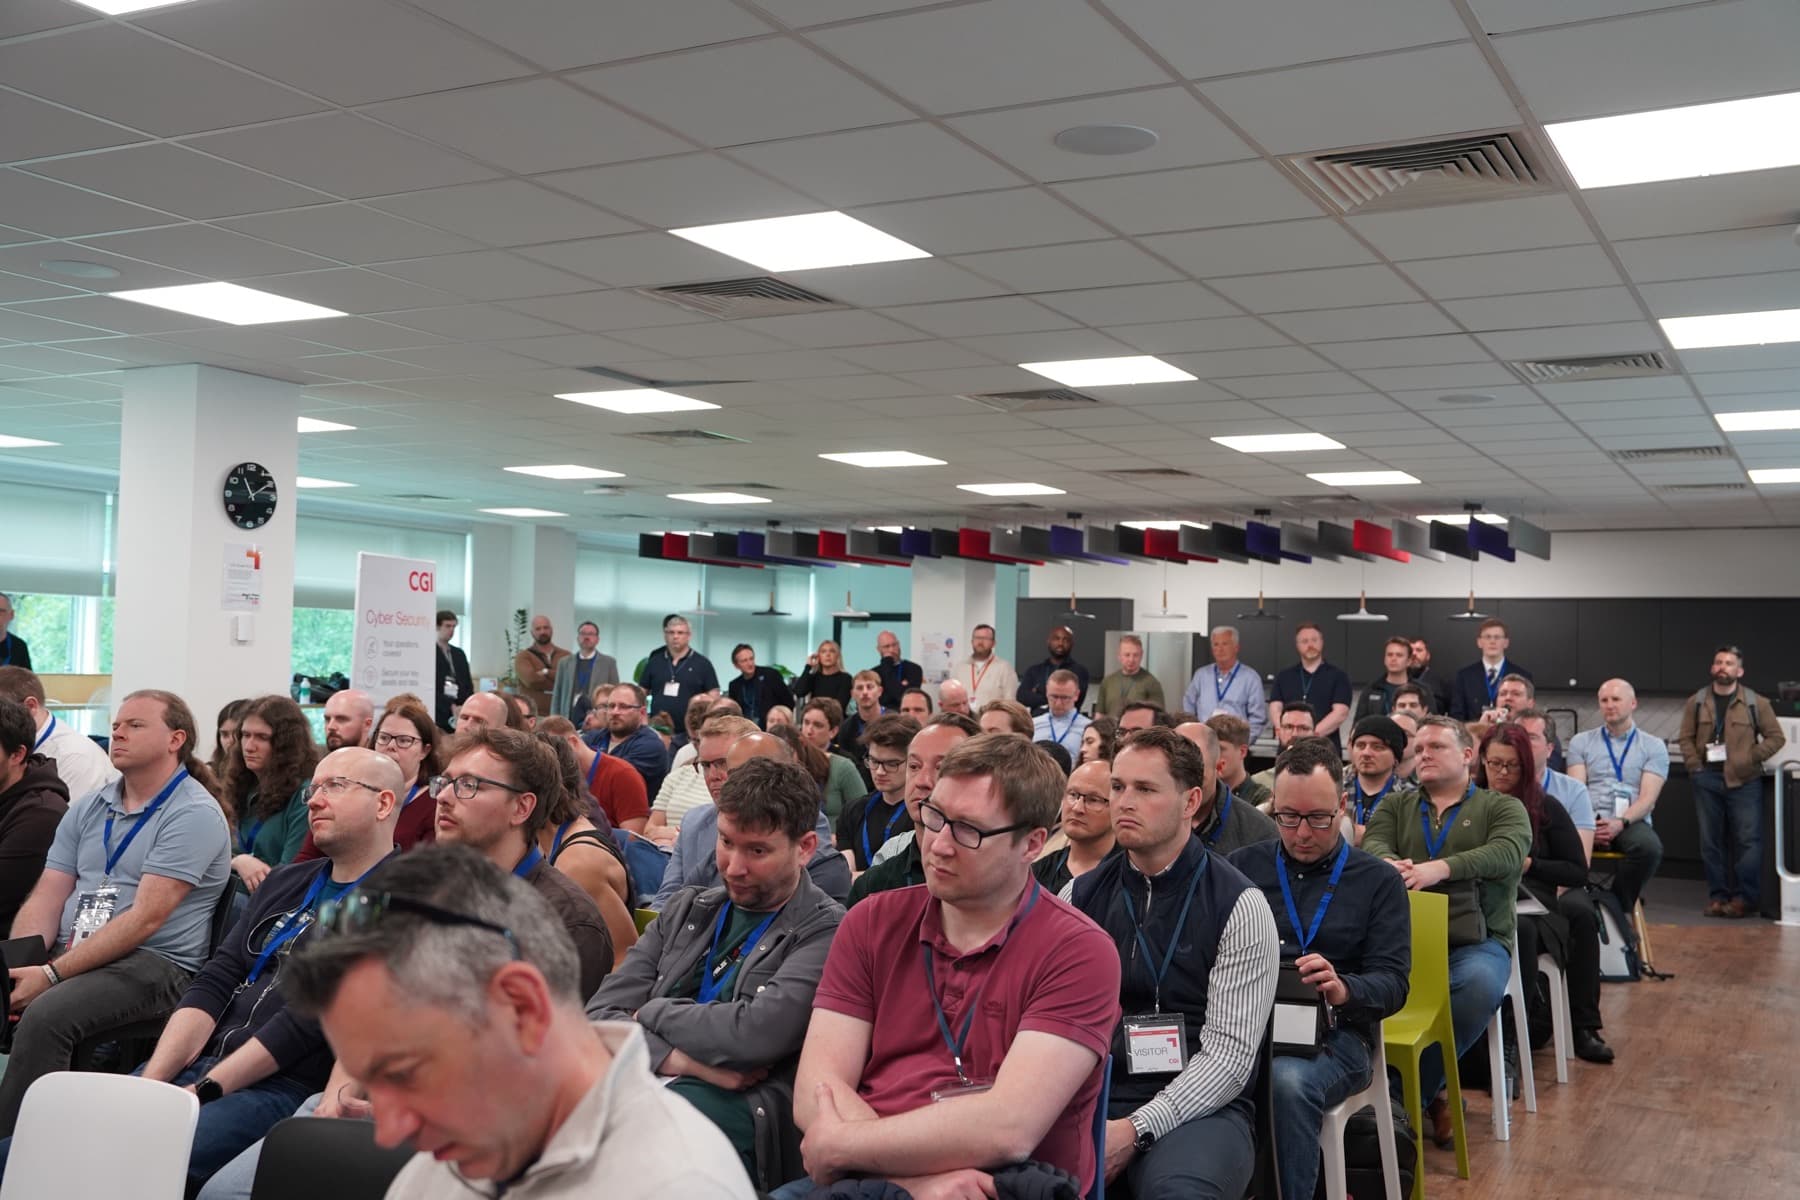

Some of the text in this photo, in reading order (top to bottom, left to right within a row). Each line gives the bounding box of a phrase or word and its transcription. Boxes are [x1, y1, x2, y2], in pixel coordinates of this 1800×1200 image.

[237, 467, 244, 475] 11
[247, 463, 256, 471] 12
[230, 477, 239, 485] 10
[235, 515, 243, 524] 7
[409, 571, 433, 592] CGI
[366, 609, 432, 632] Cyber Security
[1134, 1047, 1168, 1057] VISITOR
